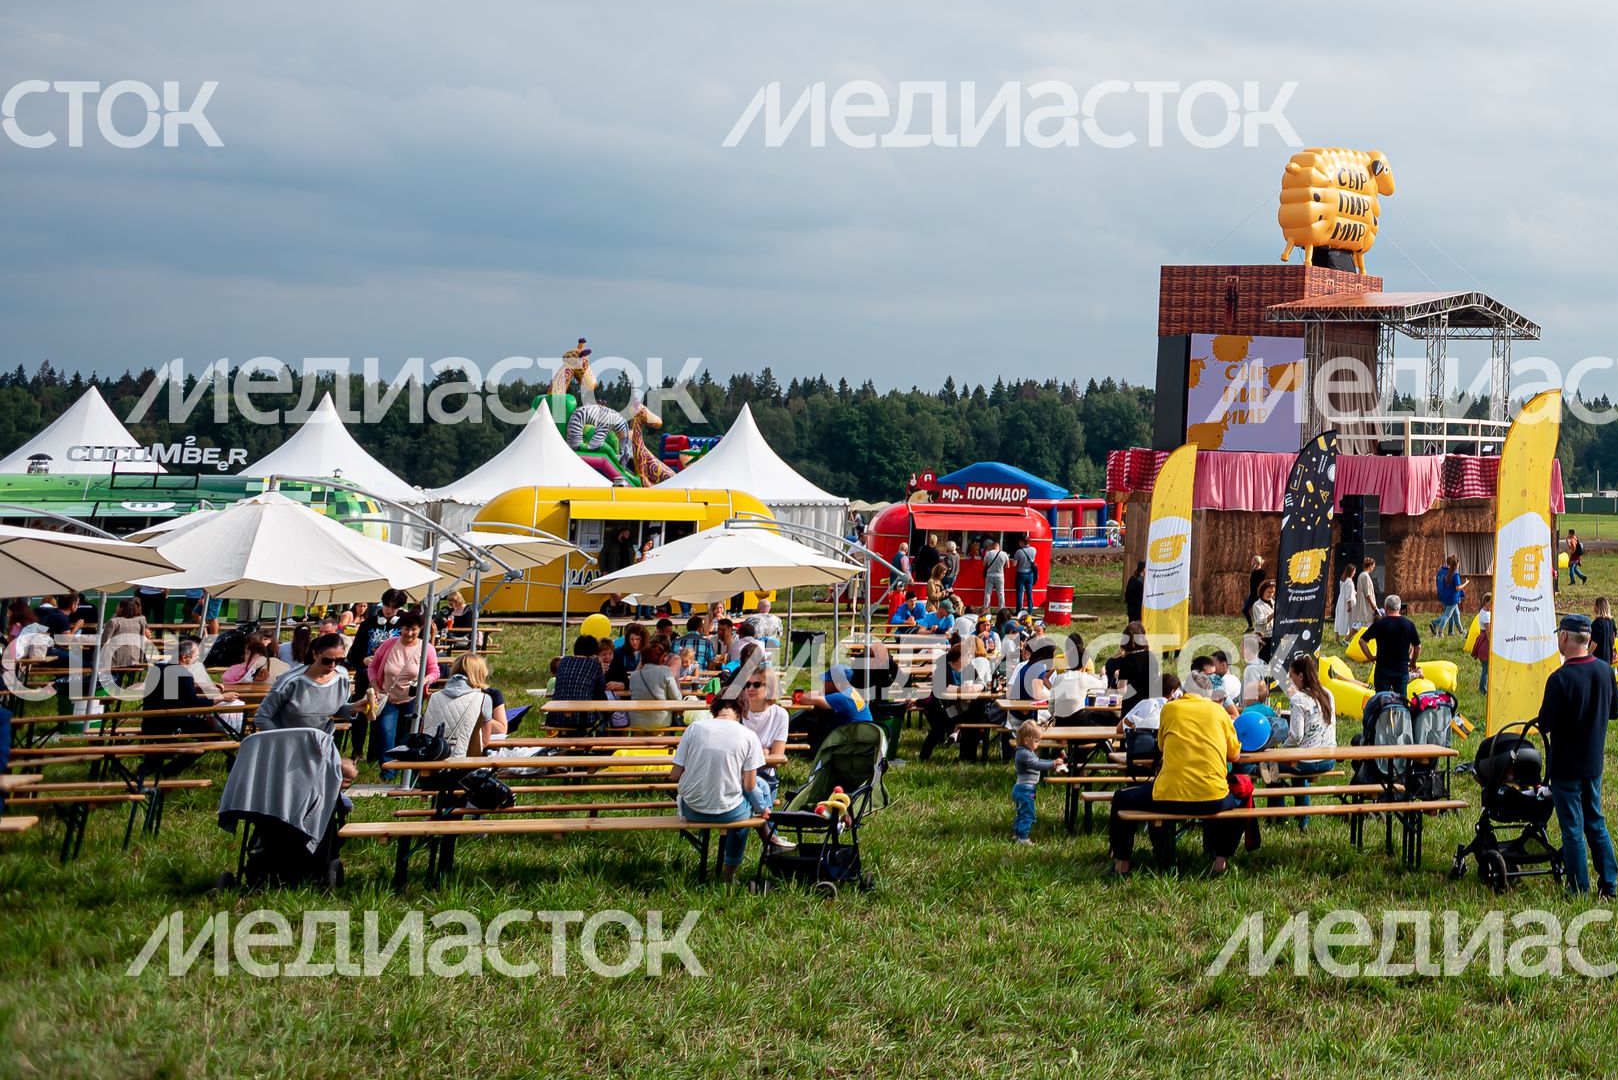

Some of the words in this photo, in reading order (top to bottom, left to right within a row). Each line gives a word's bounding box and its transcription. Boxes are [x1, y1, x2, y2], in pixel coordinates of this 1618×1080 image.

[1337, 167, 1367, 191] СЫР
[1338, 192, 1370, 218] ПИР
[1330, 221, 1366, 242] МИР
[1224, 364, 1269, 382] СЫР
[1222, 385, 1270, 404] ПИР
[1222, 407, 1268, 425] МИР
[967, 486, 1027, 503] ПОМИДОР
